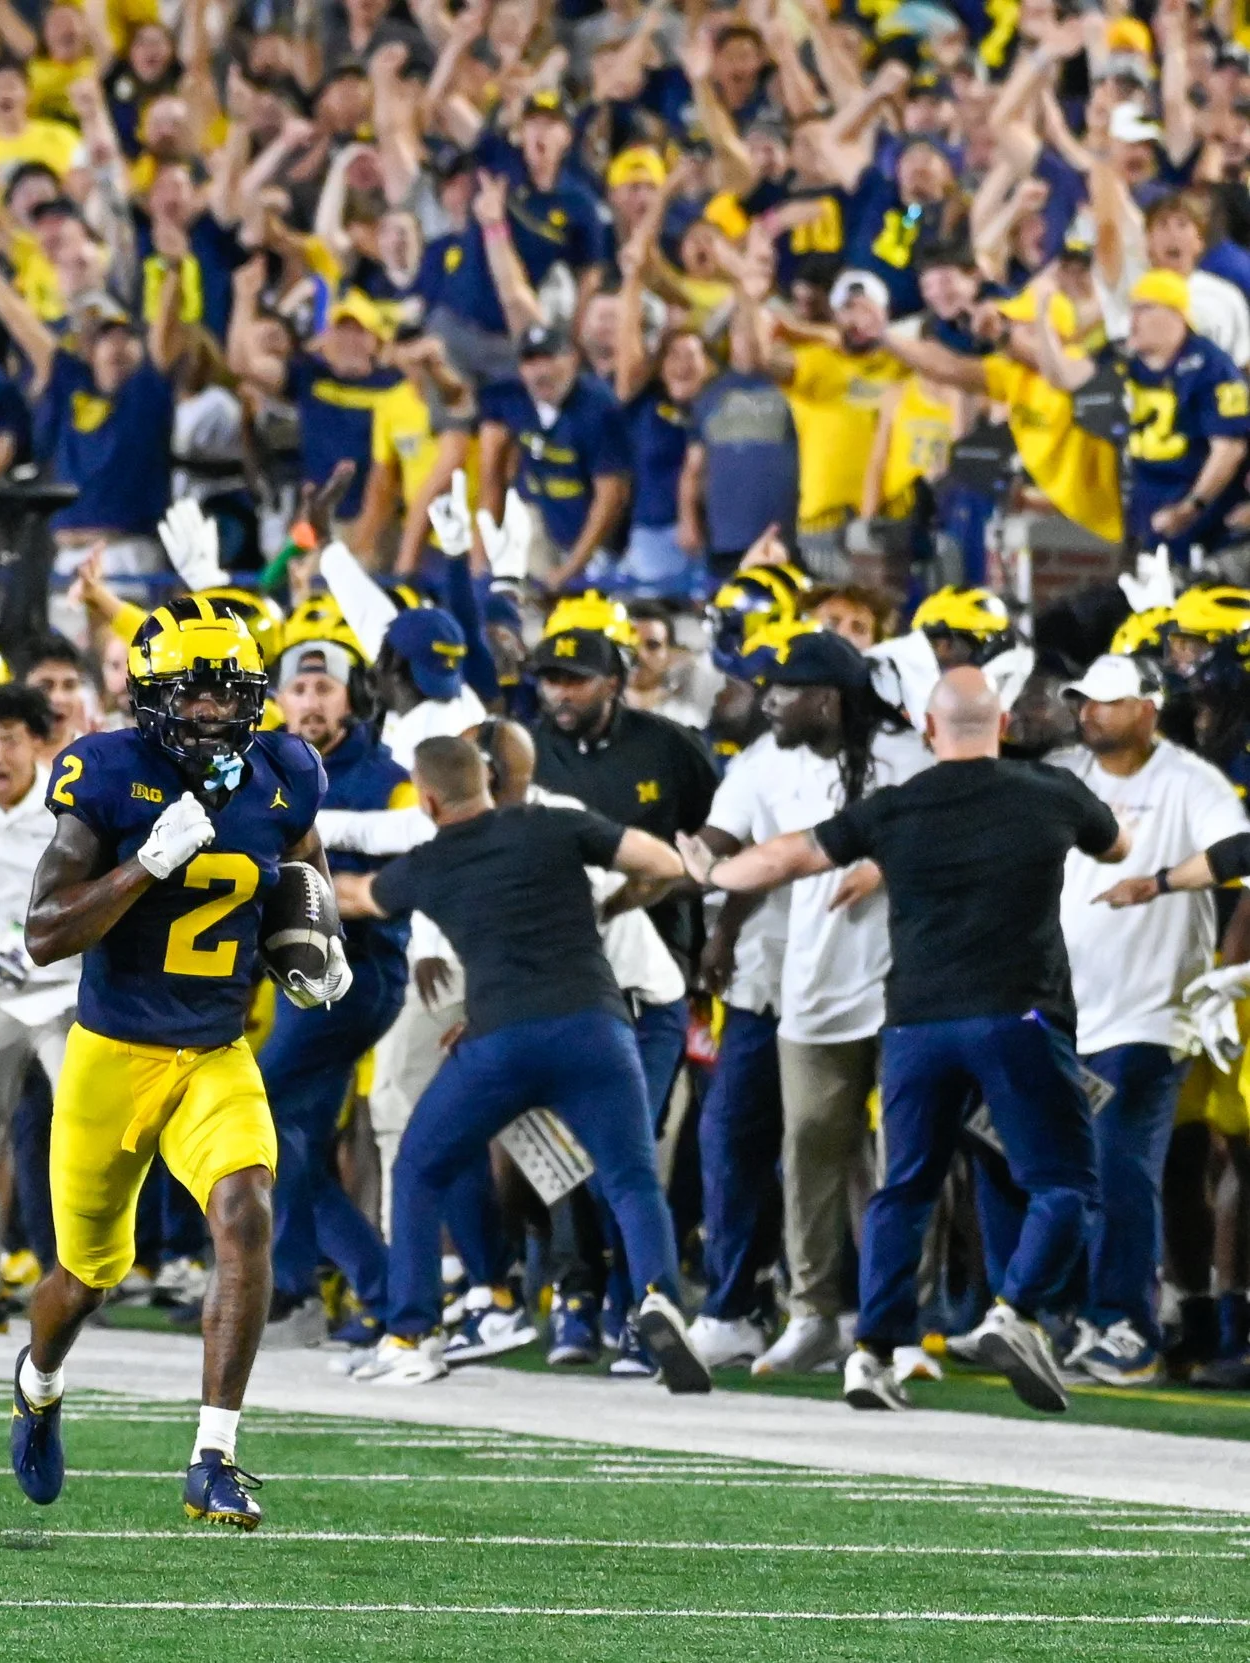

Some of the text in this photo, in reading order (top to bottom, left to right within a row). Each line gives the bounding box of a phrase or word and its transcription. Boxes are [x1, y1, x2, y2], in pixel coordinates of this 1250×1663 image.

[210, 659, 222, 669] M
[52, 754, 83, 807] 2
[163, 853, 259, 977] 2
